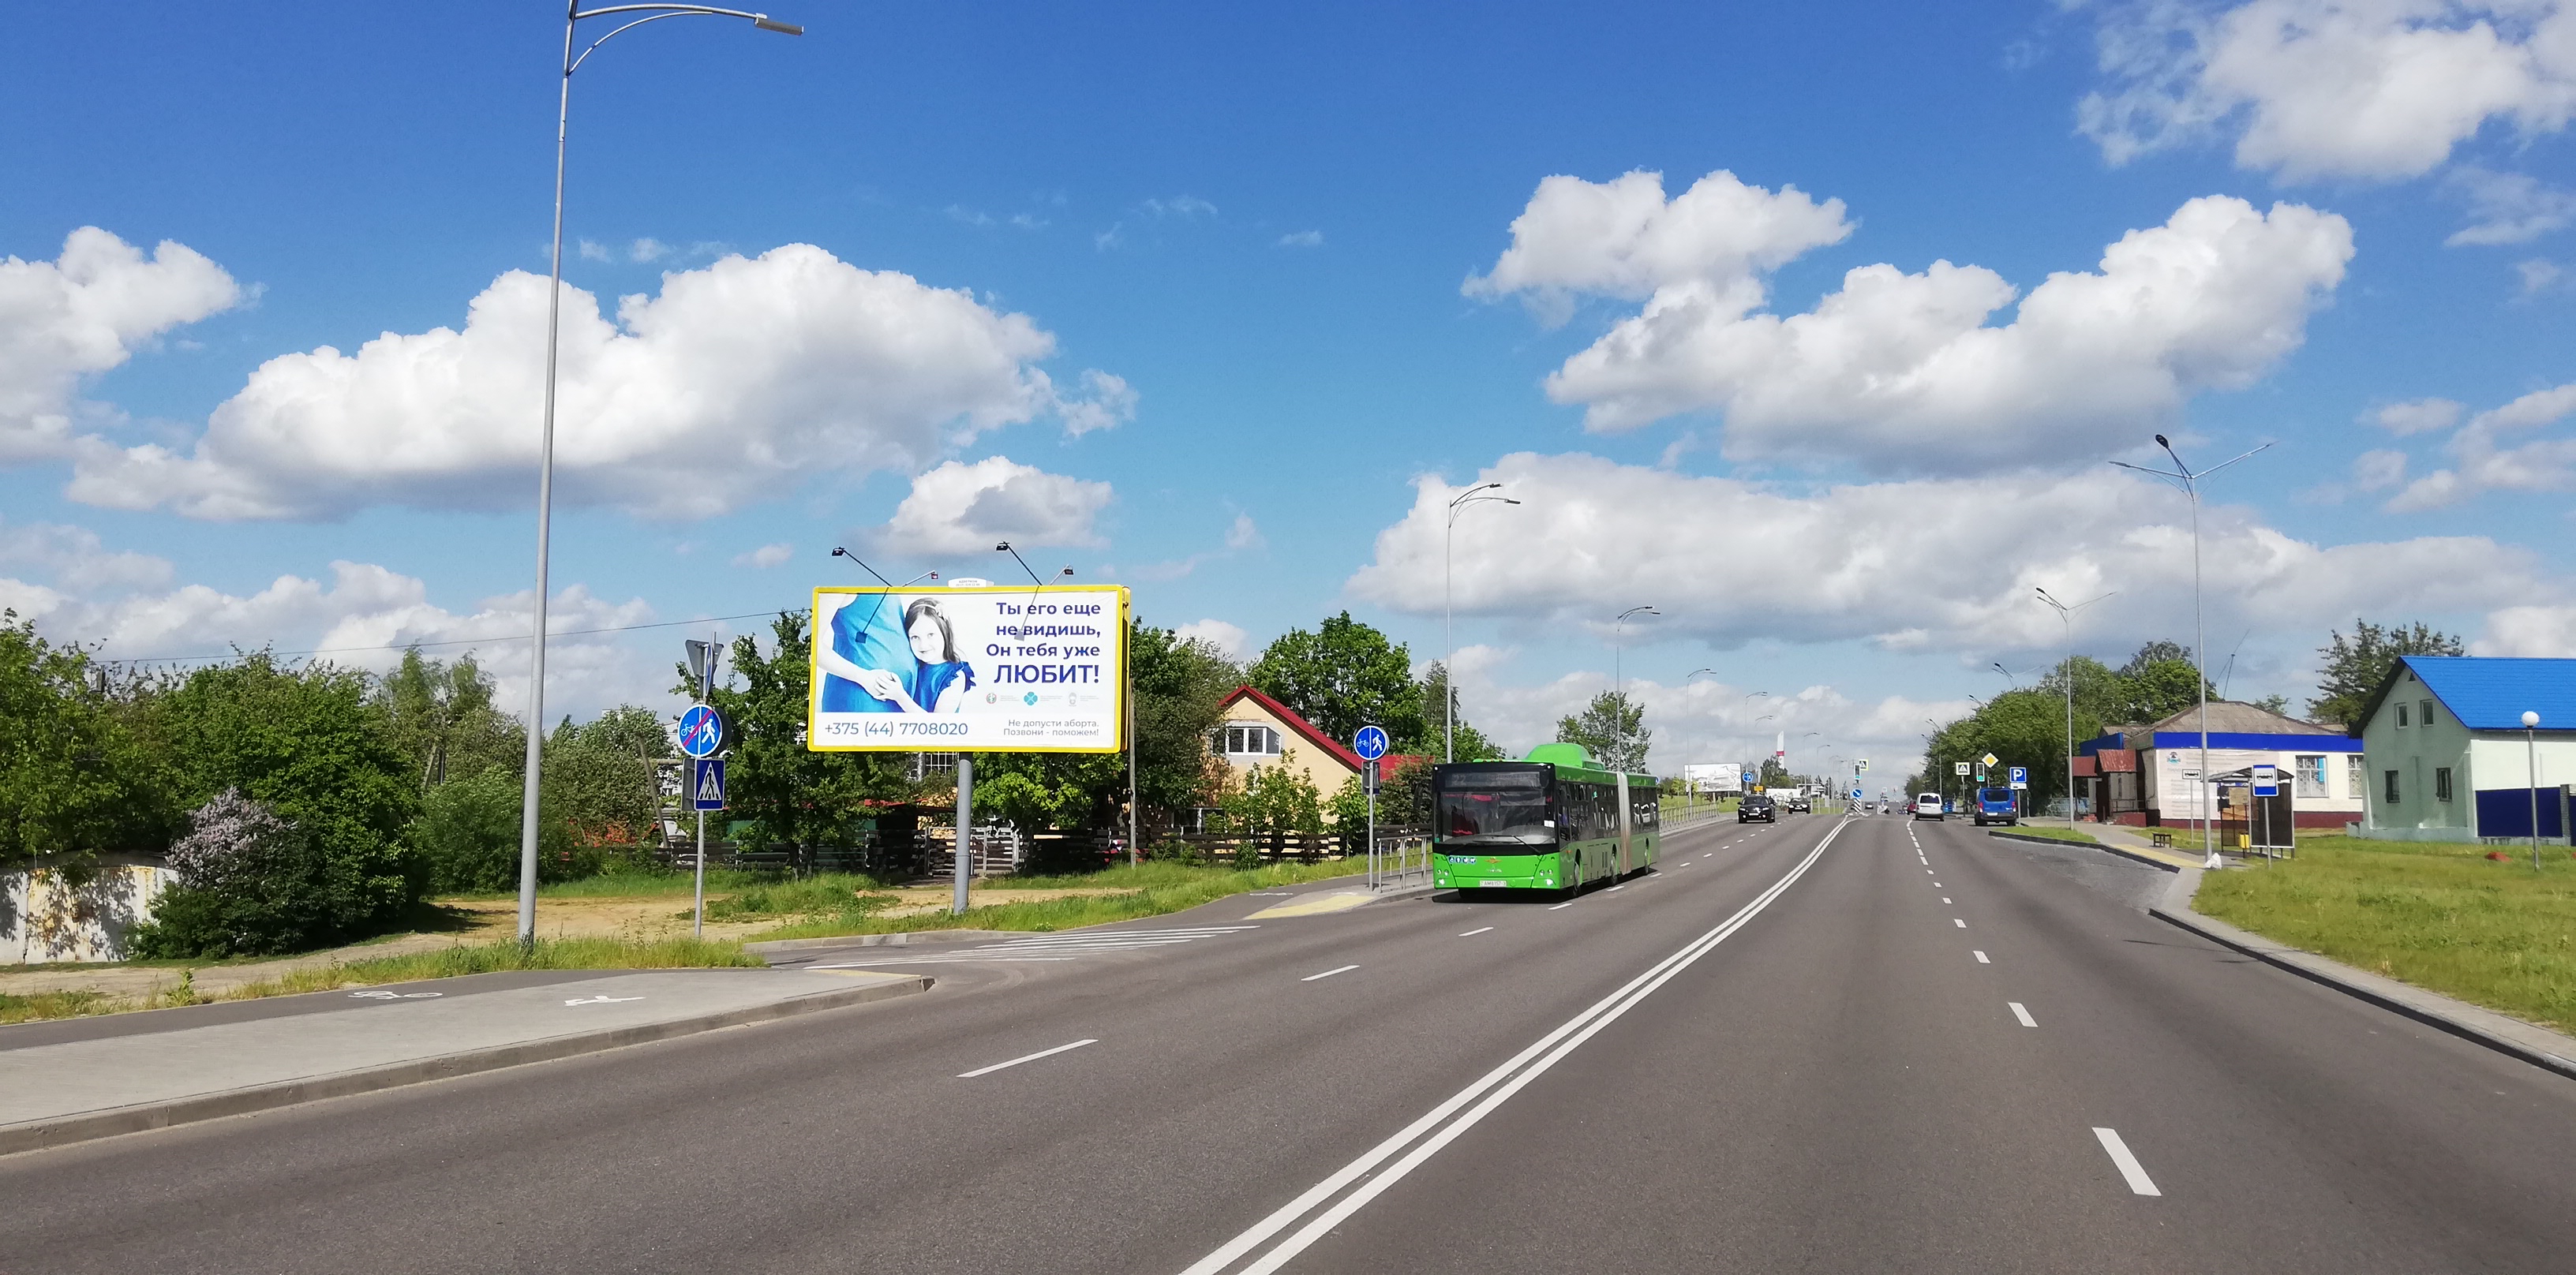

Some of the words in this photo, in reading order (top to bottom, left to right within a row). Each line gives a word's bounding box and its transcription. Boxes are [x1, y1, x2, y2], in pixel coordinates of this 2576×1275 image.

[996, 603, 1020, 615] Ты
[1028, 604, 1058, 615] его
[1063, 604, 1101, 616] еще
[996, 626, 1018, 636] не
[1023, 625, 1101, 638] видишь,
[987, 644, 1011, 657] Он
[1017, 642, 1058, 657] тебя
[1063, 645, 1101, 660] уже
[994, 664, 1099, 685] ЛЮБИТ!
[826, 722, 859, 735] +375
[864, 721, 893, 738] (44)
[900, 722, 968, 735] 7708020
[1023, 720, 1061, 730] допусти
[1064, 719, 1099, 730] аборта.
[1003, 727, 1043, 736] Позвони
[1052, 727, 1099, 736] поможем!
[2013, 769, 2023, 781] P
